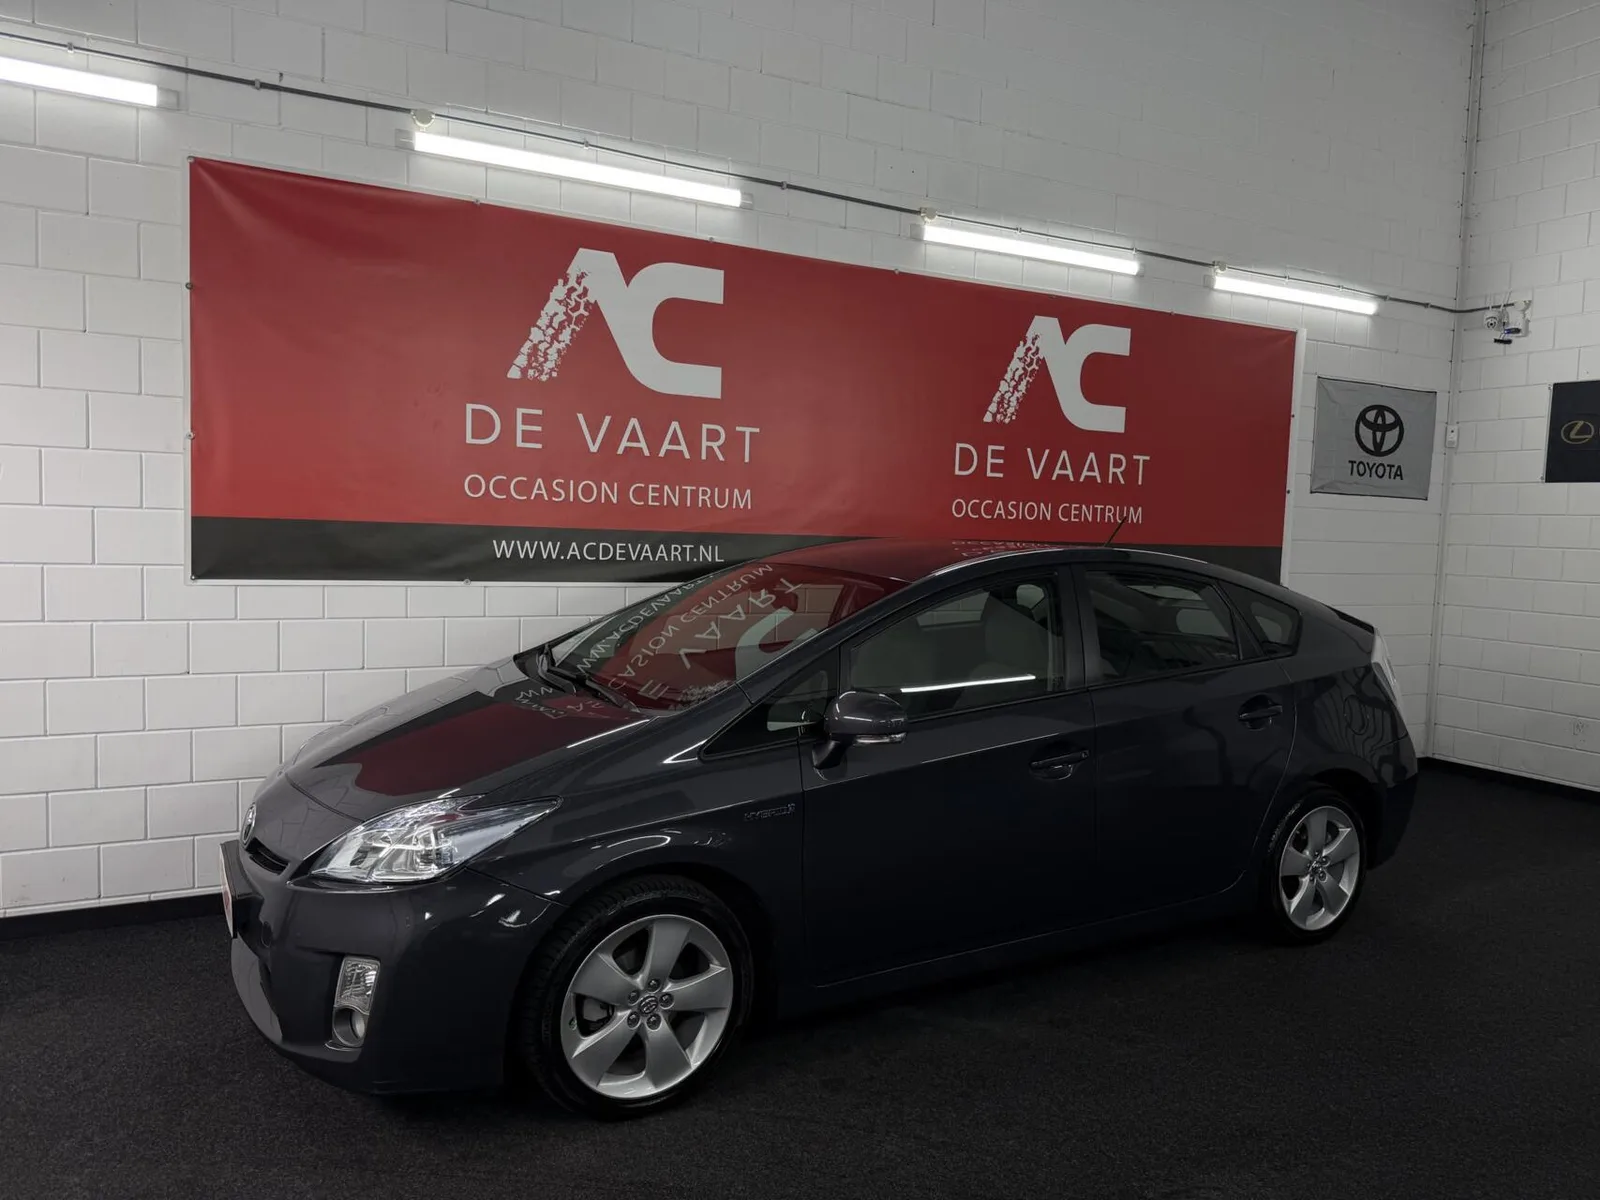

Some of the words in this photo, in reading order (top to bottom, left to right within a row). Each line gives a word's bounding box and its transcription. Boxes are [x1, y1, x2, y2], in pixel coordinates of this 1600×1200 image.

[506, 247, 724, 399] AC
[982, 315, 1132, 433] AC
[465, 403, 543, 448] DE
[576, 412, 760, 463] VAART
[954, 442, 1005, 478] DE
[1027, 447, 1150, 485] VAART
[1348, 459, 1404, 480] TOYOTA
[463, 473, 618, 504] OCCASION
[629, 482, 752, 510] CENTRUM
[952, 498, 1051, 521] OCCASION
[1058, 503, 1143, 524] CENTRUM
[492, 539, 725, 563] WWW.ACDEVAART.NL
